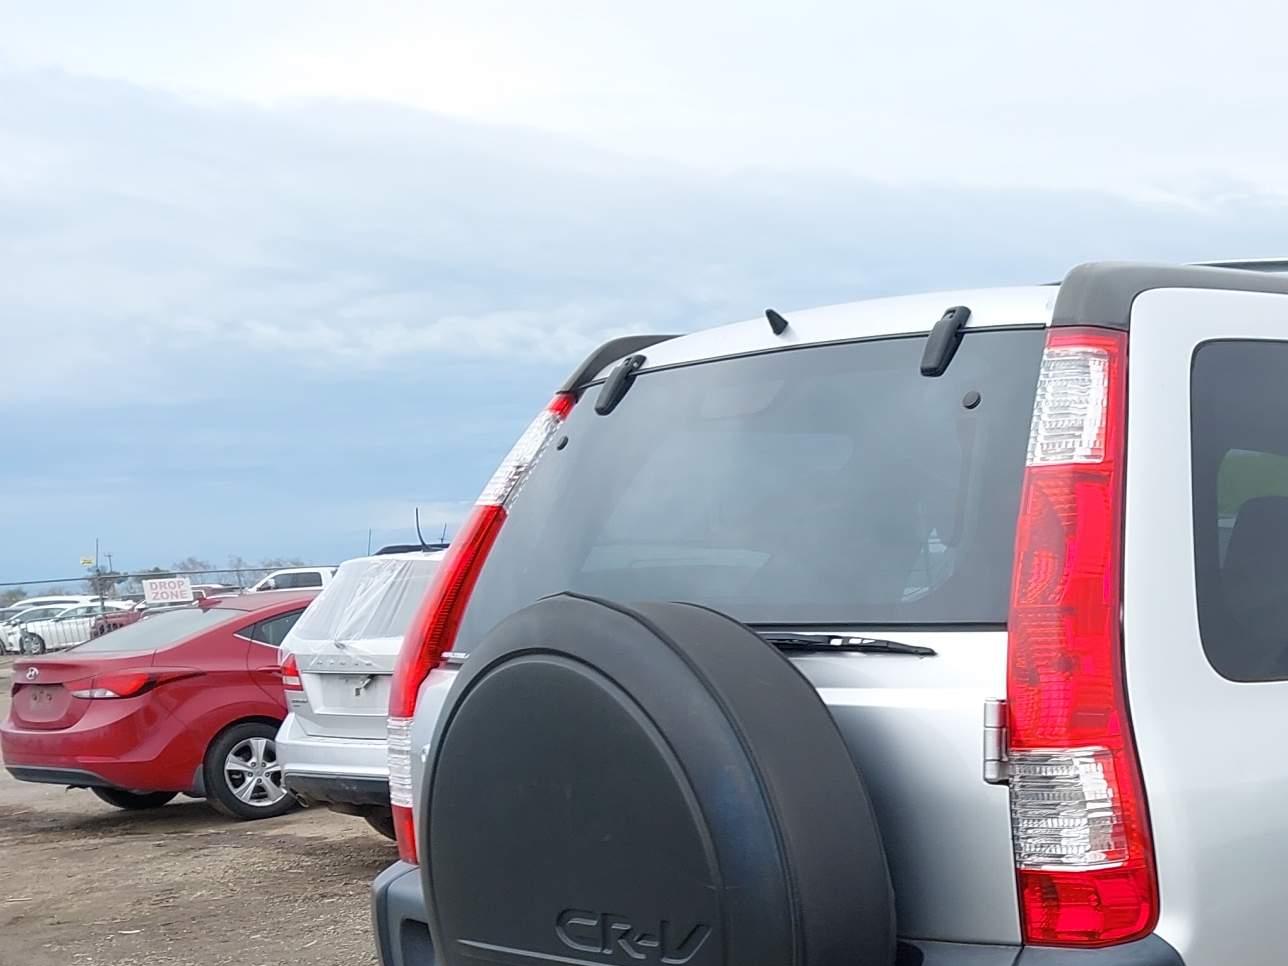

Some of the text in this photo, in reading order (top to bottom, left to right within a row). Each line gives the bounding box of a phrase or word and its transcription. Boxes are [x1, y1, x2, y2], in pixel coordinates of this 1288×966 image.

[150, 580, 184, 590] DROP
[152, 590, 188, 600] ZONE
[555, 908, 712, 965] CR-V
